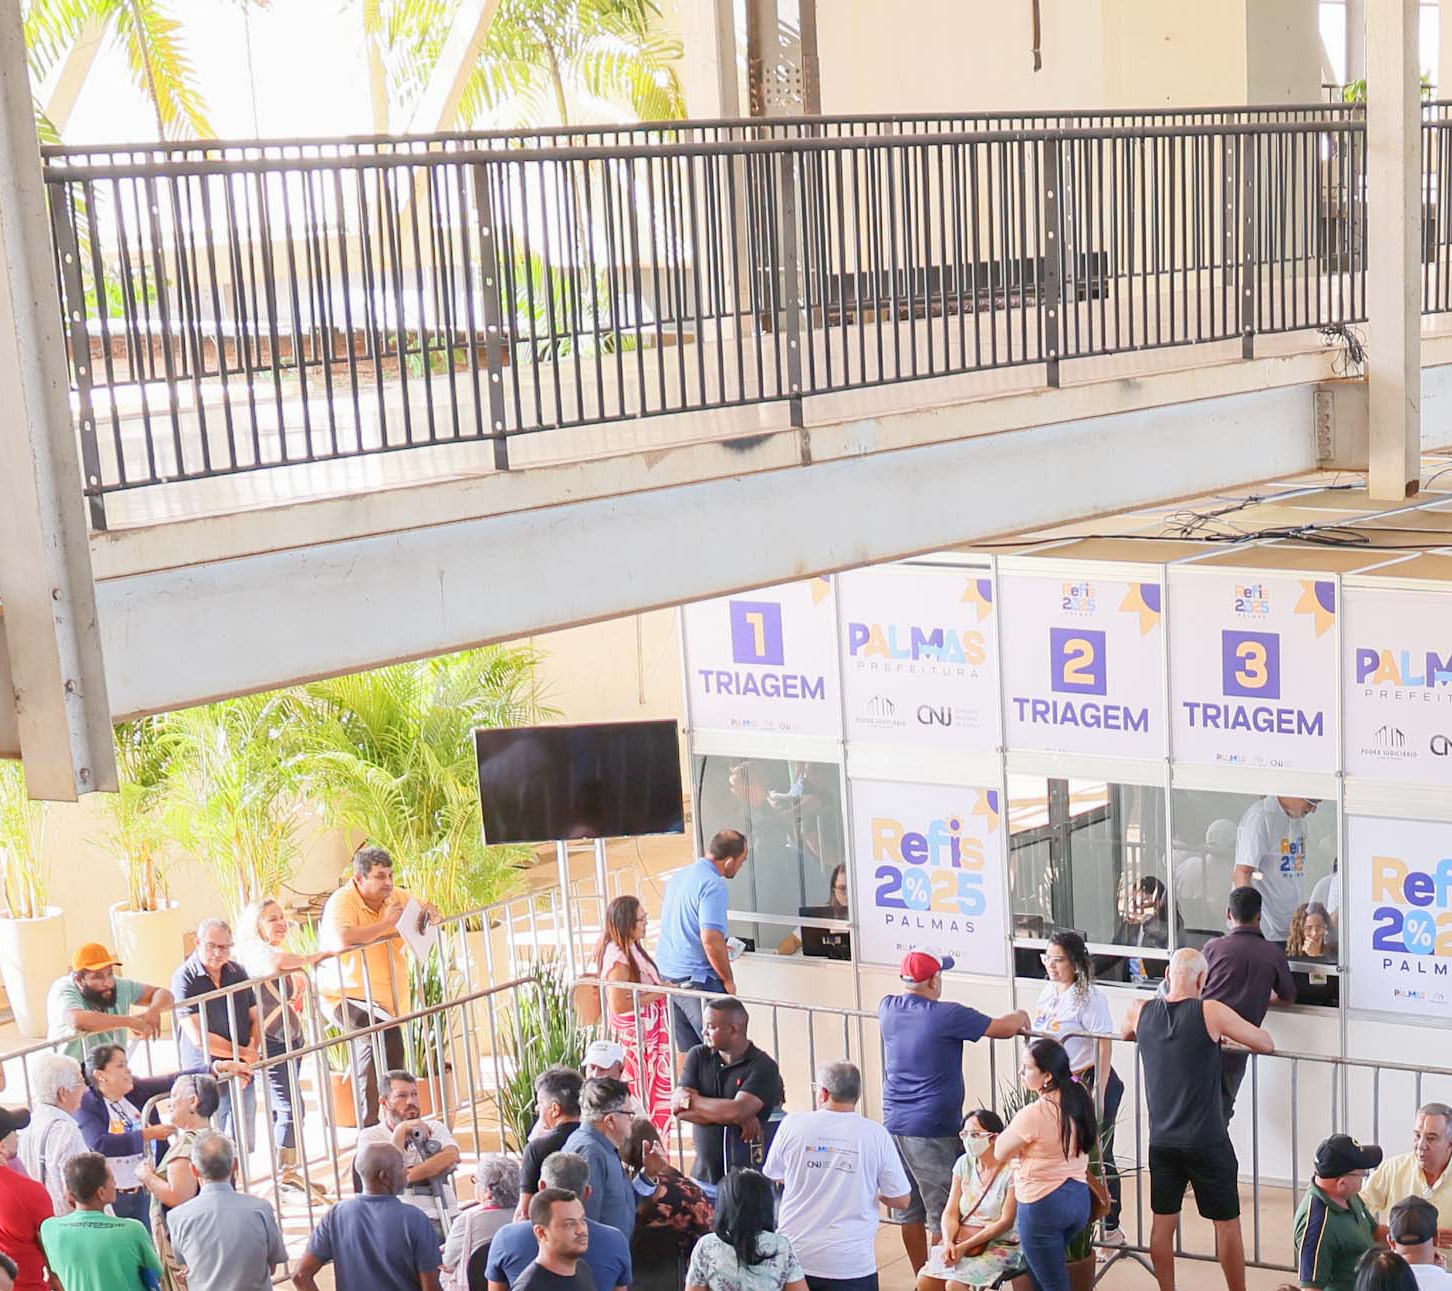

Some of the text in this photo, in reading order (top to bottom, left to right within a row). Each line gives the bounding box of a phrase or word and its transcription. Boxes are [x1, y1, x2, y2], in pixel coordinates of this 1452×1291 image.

[746, 612, 765, 656] 1
[849, 622, 986, 665] PALMAS
[858, 661, 980, 678] PREFEITURA
[1063, 639, 1095, 685] 2
[1235, 641, 1268, 689] 3
[698, 670, 825, 700] TRIAGEM
[917, 704, 952, 726] CNJ
[1013, 698, 1148, 733] TRIAGEM
[1183, 702, 1324, 736] TRIAGEM
[871, 814, 985, 870] Refis
[875, 865, 985, 916] 2025
[886, 914, 974, 933] PALMAS
